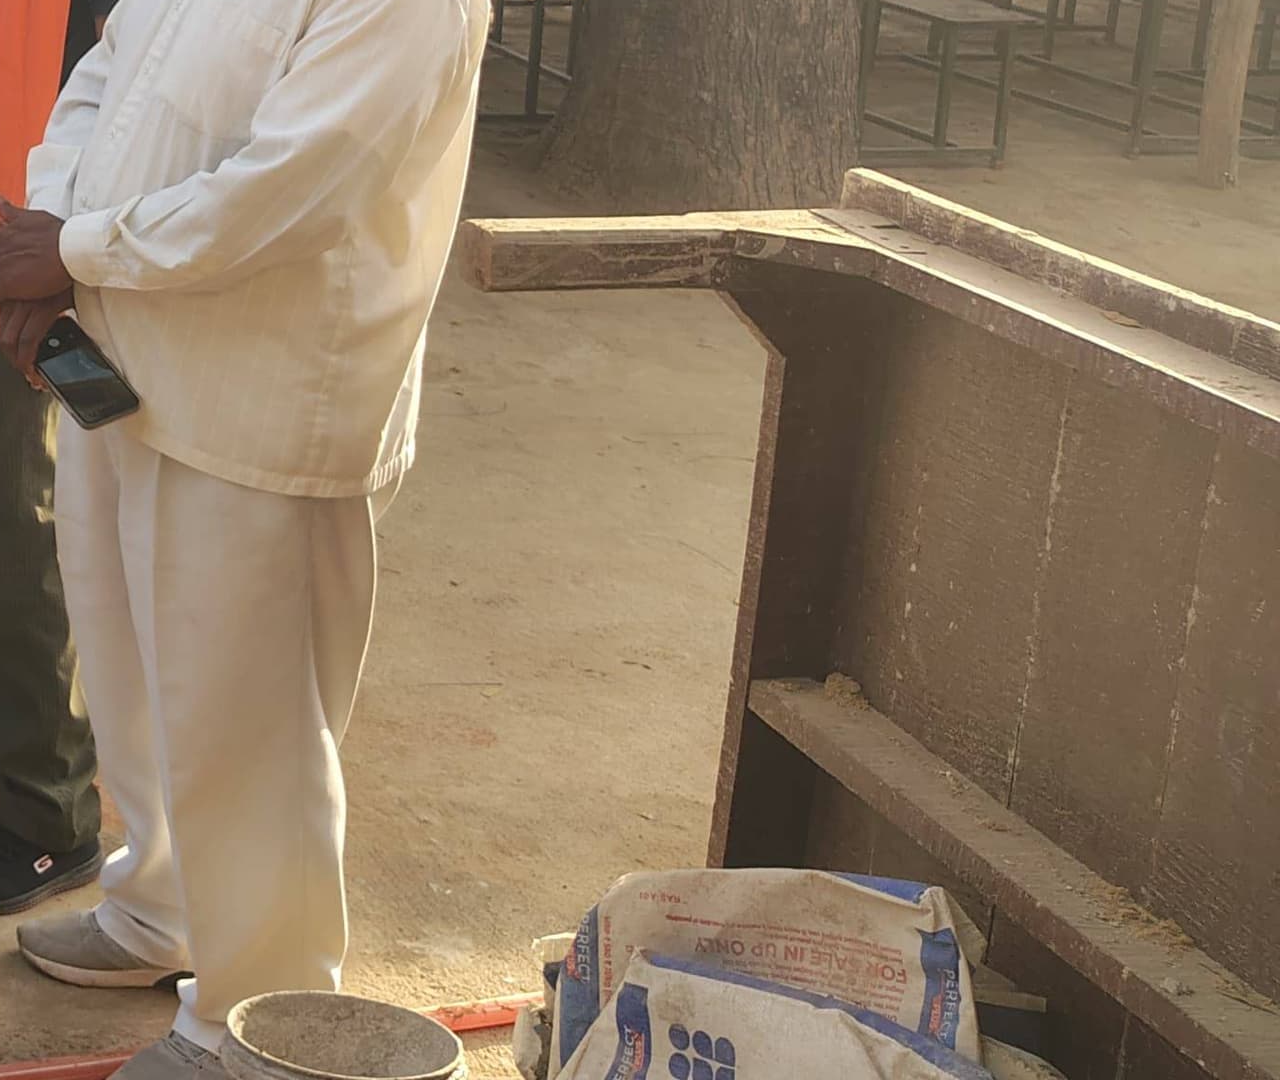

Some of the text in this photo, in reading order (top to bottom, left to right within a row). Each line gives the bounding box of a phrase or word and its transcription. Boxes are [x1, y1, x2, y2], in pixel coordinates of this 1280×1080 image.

[694, 937, 908, 985] FOR SALE IN UP ONLY
[938, 968, 959, 1041] PERFECT
[613, 1023, 635, 1080] ERFECT
